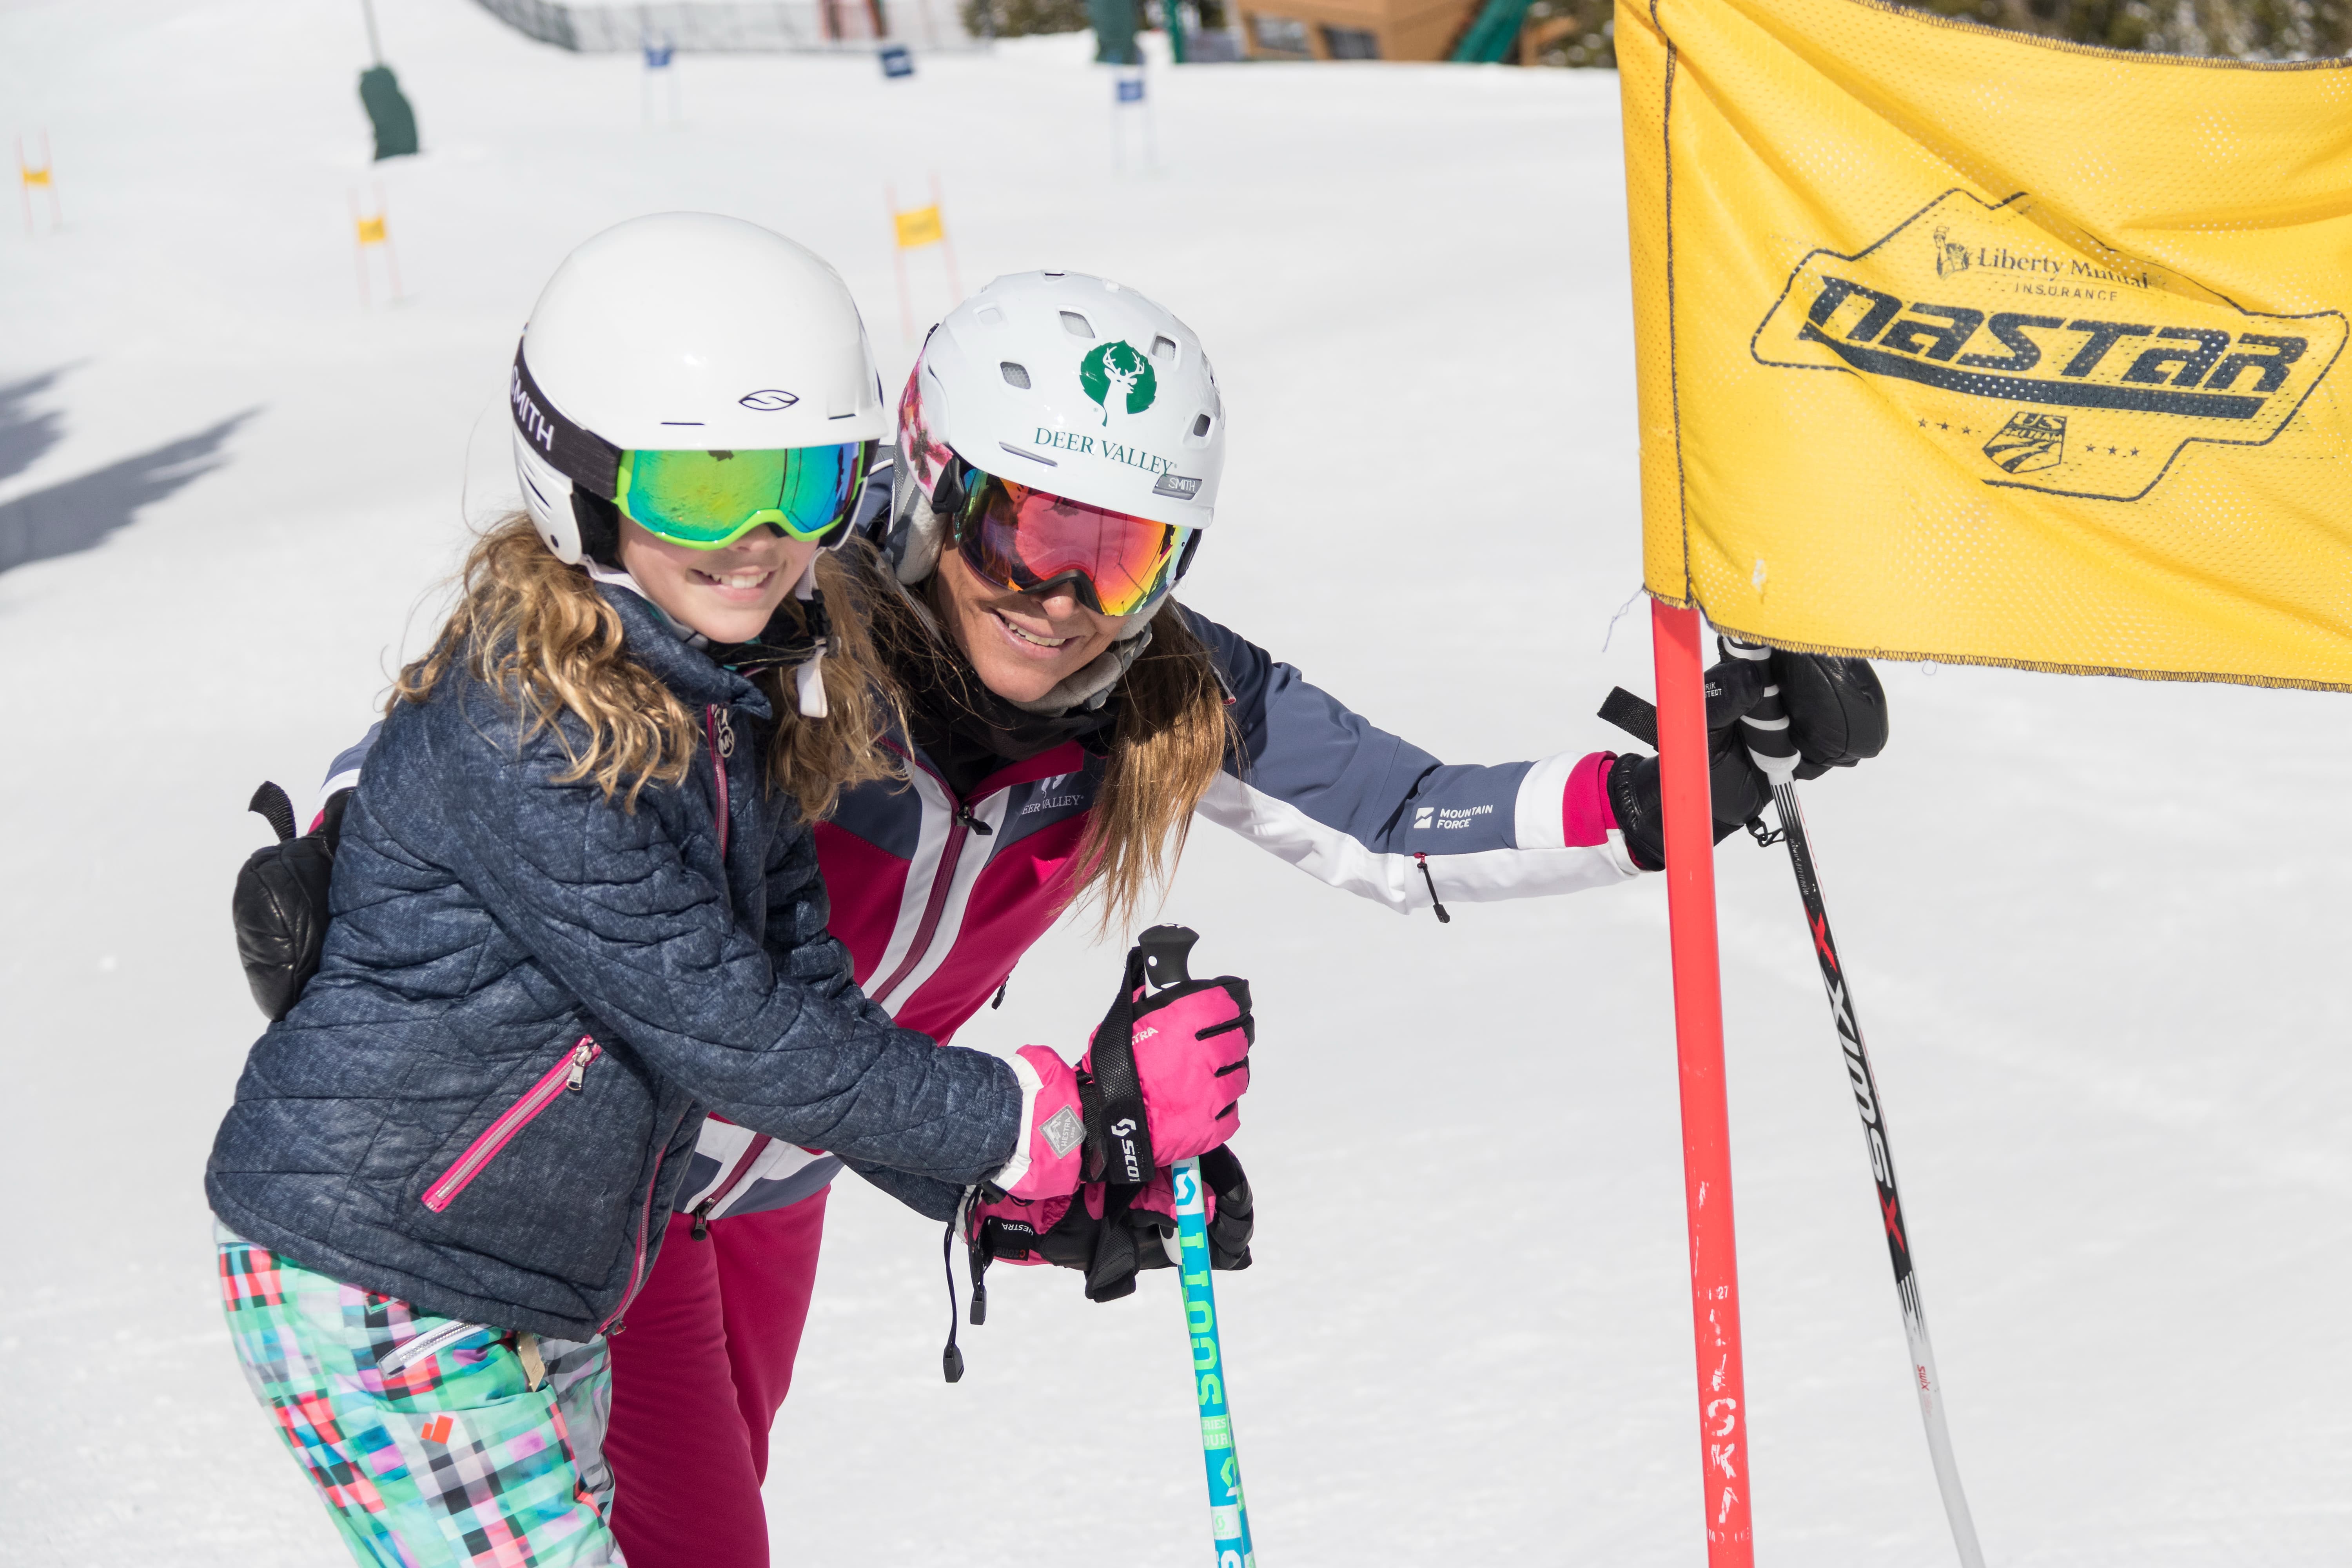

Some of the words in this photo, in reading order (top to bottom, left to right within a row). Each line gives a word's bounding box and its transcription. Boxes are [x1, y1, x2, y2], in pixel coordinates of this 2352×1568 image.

[1978, 247, 2063, 281] Liberty
[2015, 282, 2118, 301] INSURANCE
[1798, 276, 2309, 392] NASTAR
[1033, 427, 1095, 455] DEER
[1101, 440, 1174, 477] VALLEY
[1168, 477, 1195, 491] SMITH
[1705, 682, 1716, 690] RIK
[1022, 803, 1041, 815] EER
[1042, 795, 1081, 809] VALLEY
[1440, 804, 1493, 818] MOUNTAIN
[1437, 818, 1471, 829] FORCE
[1132, 1027, 1159, 1045] TRA
[1061, 1116, 1071, 1147] HESTRA
[1002, 1223, 1034, 1236] HESTRA
